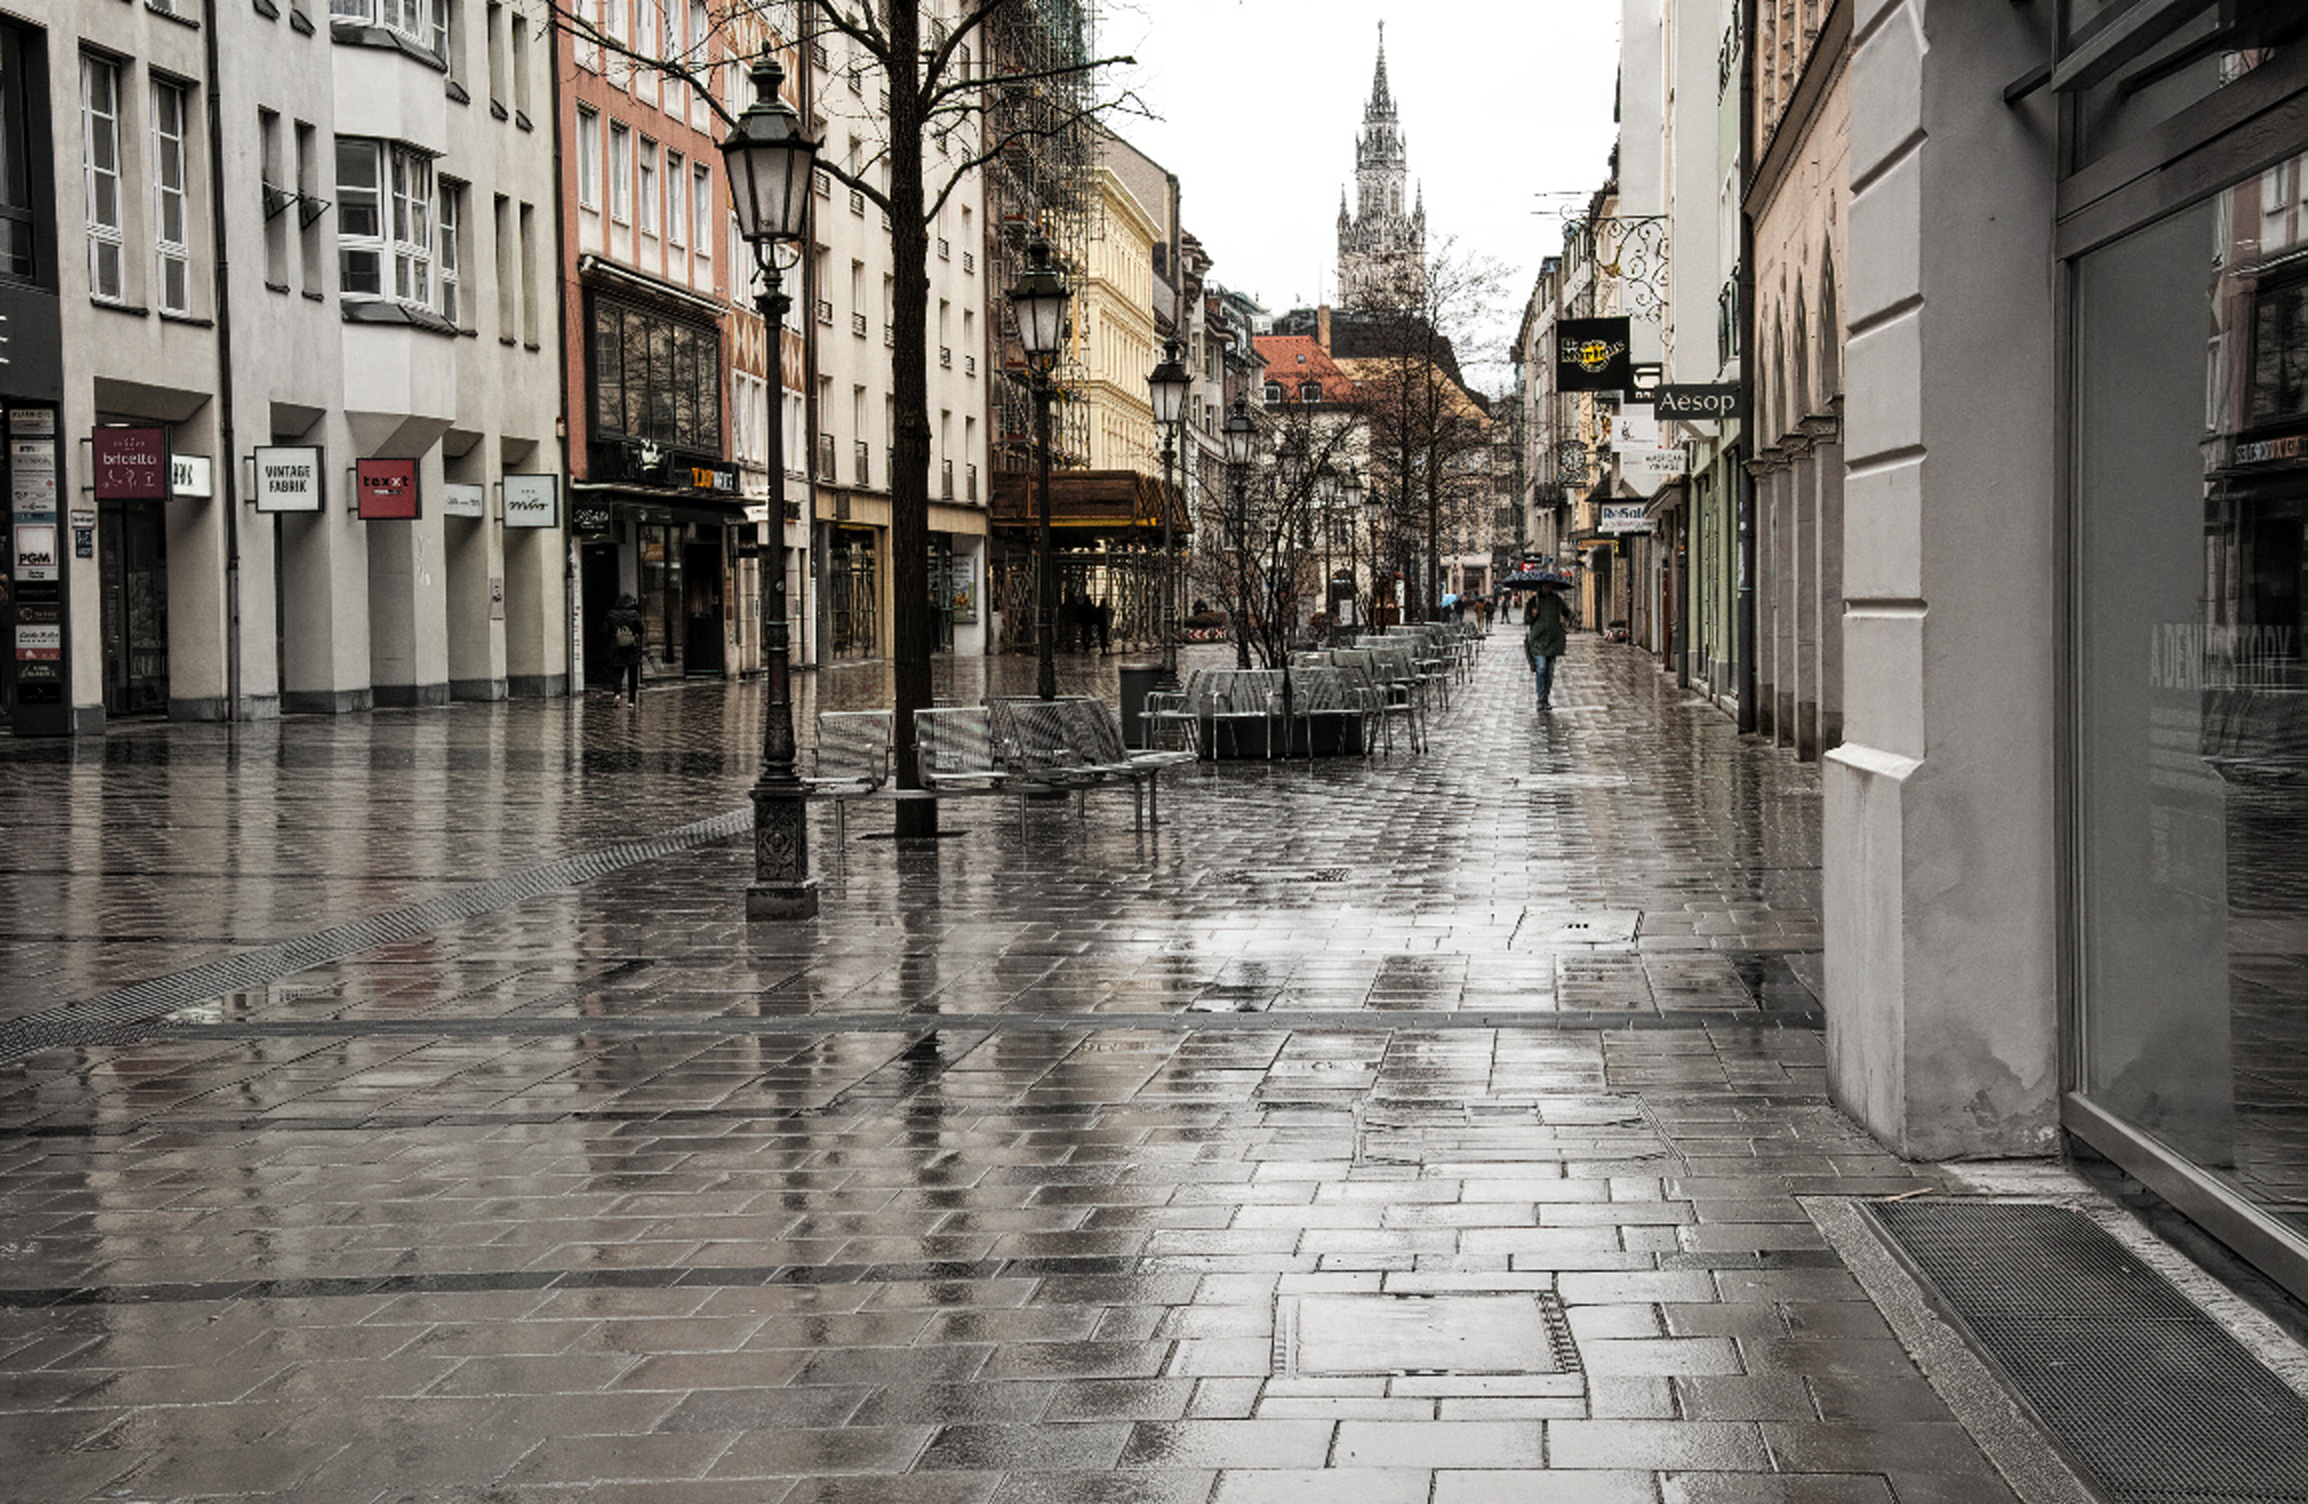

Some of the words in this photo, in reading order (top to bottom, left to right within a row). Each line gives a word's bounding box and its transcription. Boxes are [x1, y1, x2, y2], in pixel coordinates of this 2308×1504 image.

[265, 464, 311, 479] VINTAGE
[269, 478, 308, 494] FABRIK
[19, 552, 51, 564] PGM
